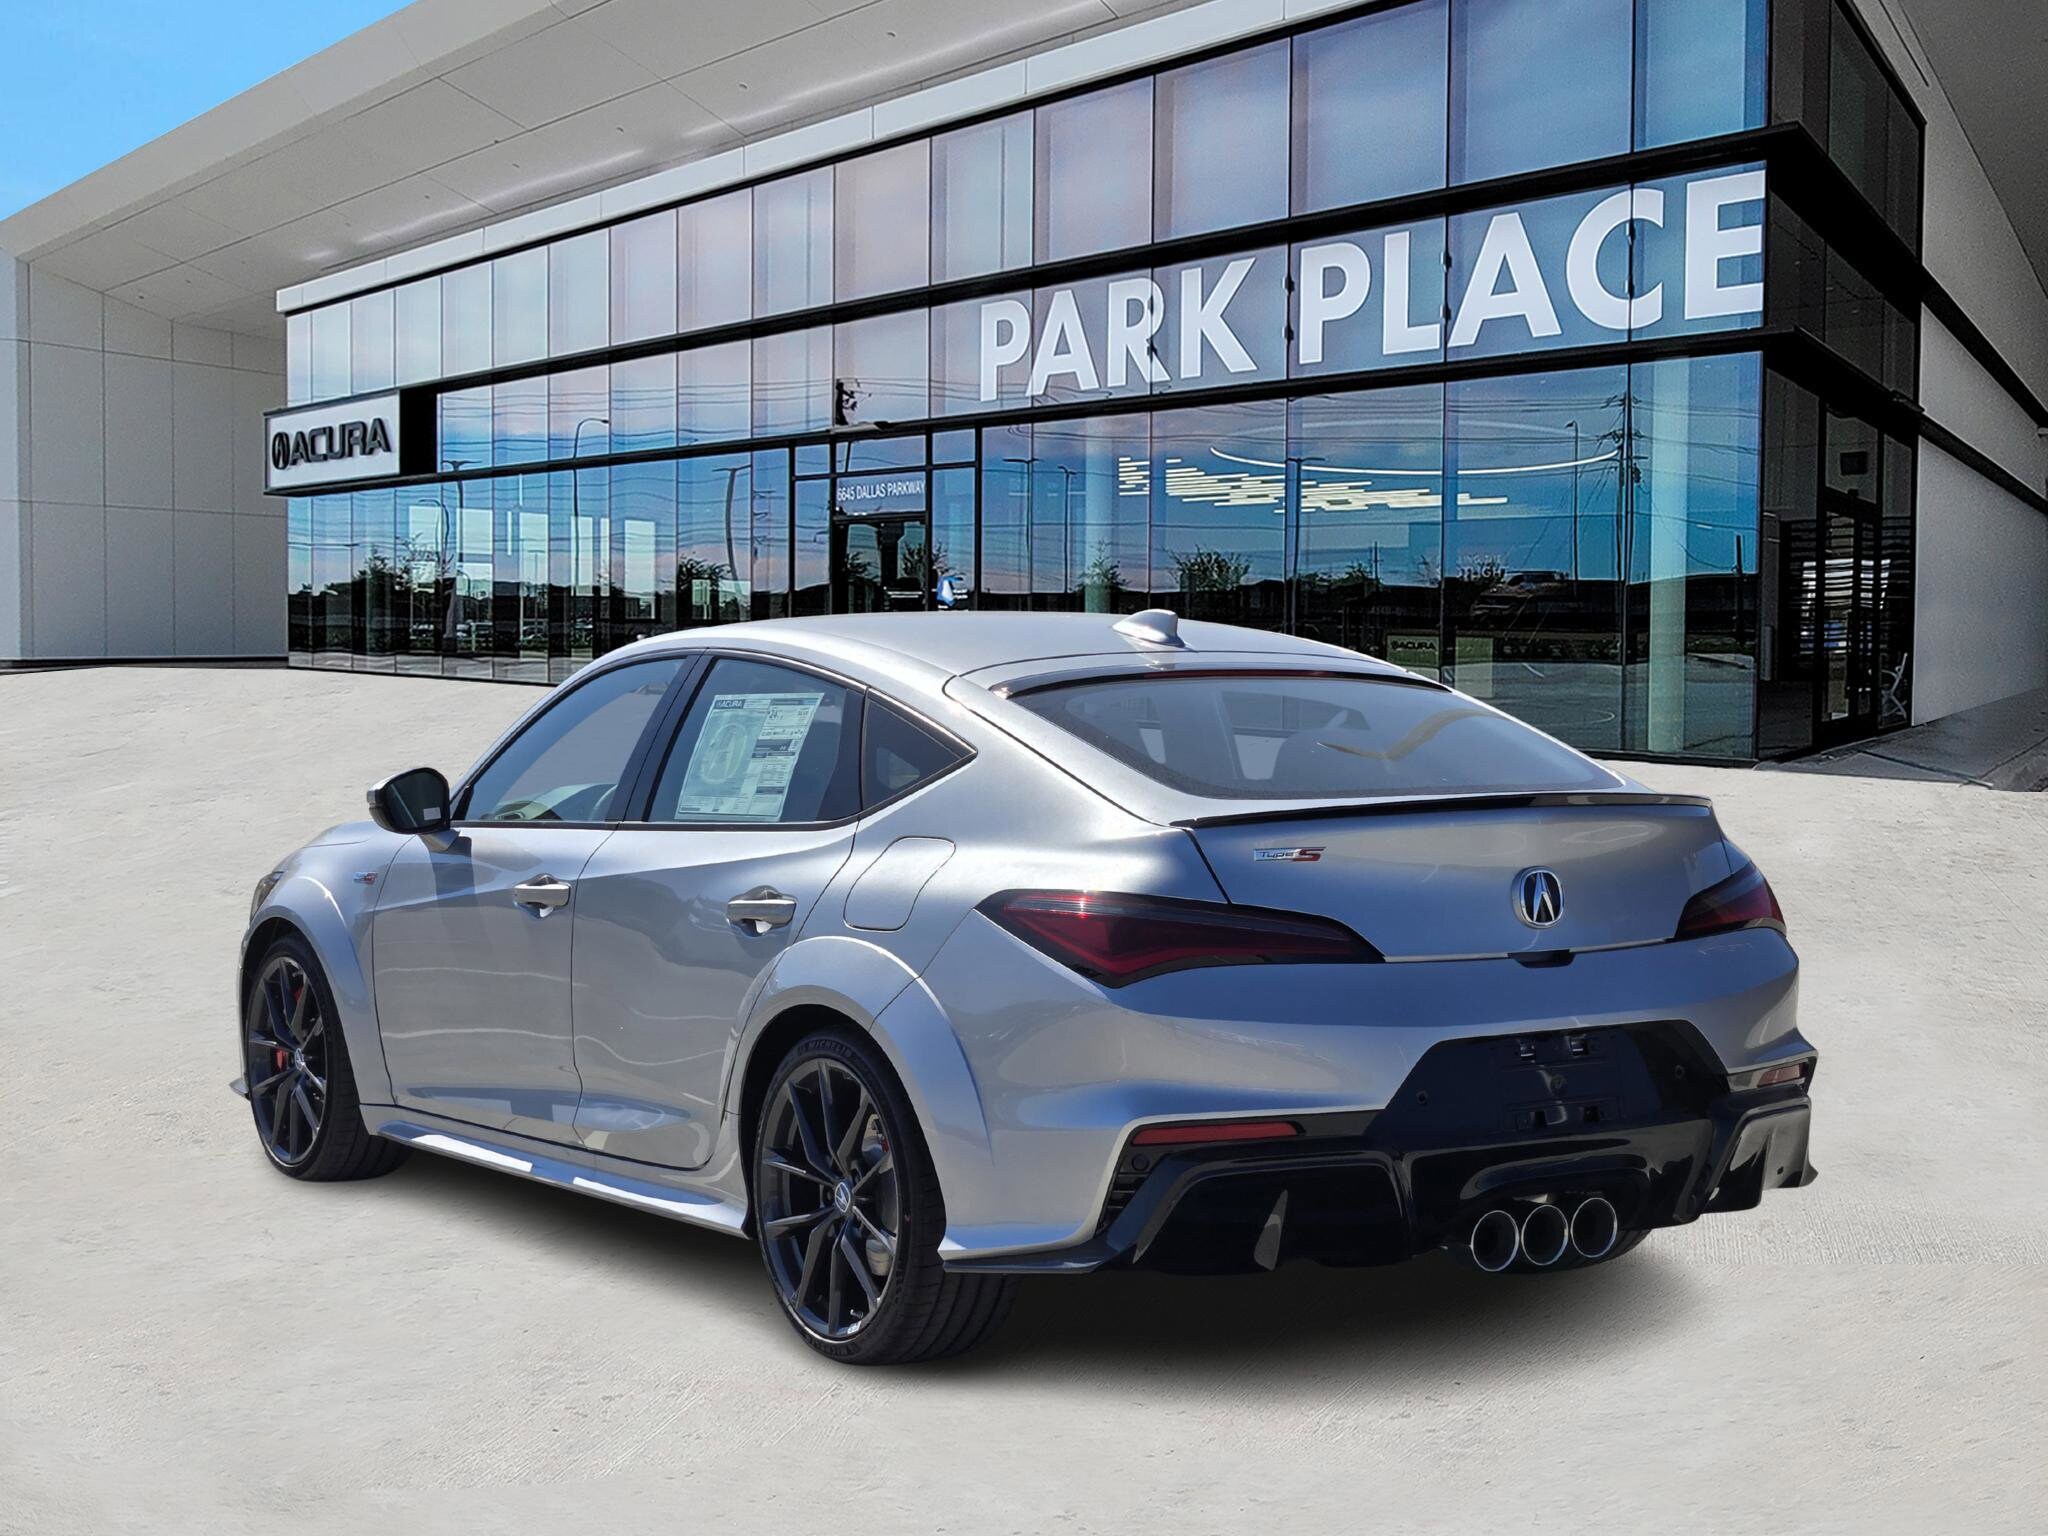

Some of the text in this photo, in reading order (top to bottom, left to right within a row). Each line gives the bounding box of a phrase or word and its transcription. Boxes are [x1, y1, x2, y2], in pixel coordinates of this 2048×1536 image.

[980, 170, 1766, 402] PARK PLACE
[289, 417, 392, 466] ACURA
[856, 483, 886, 500] DALLAS
[887, 480, 926, 497] PARKWAY
[1399, 641, 1436, 650] ACURA
[720, 700, 743, 708] ACURA
[1261, 847, 1325, 862] Type S
